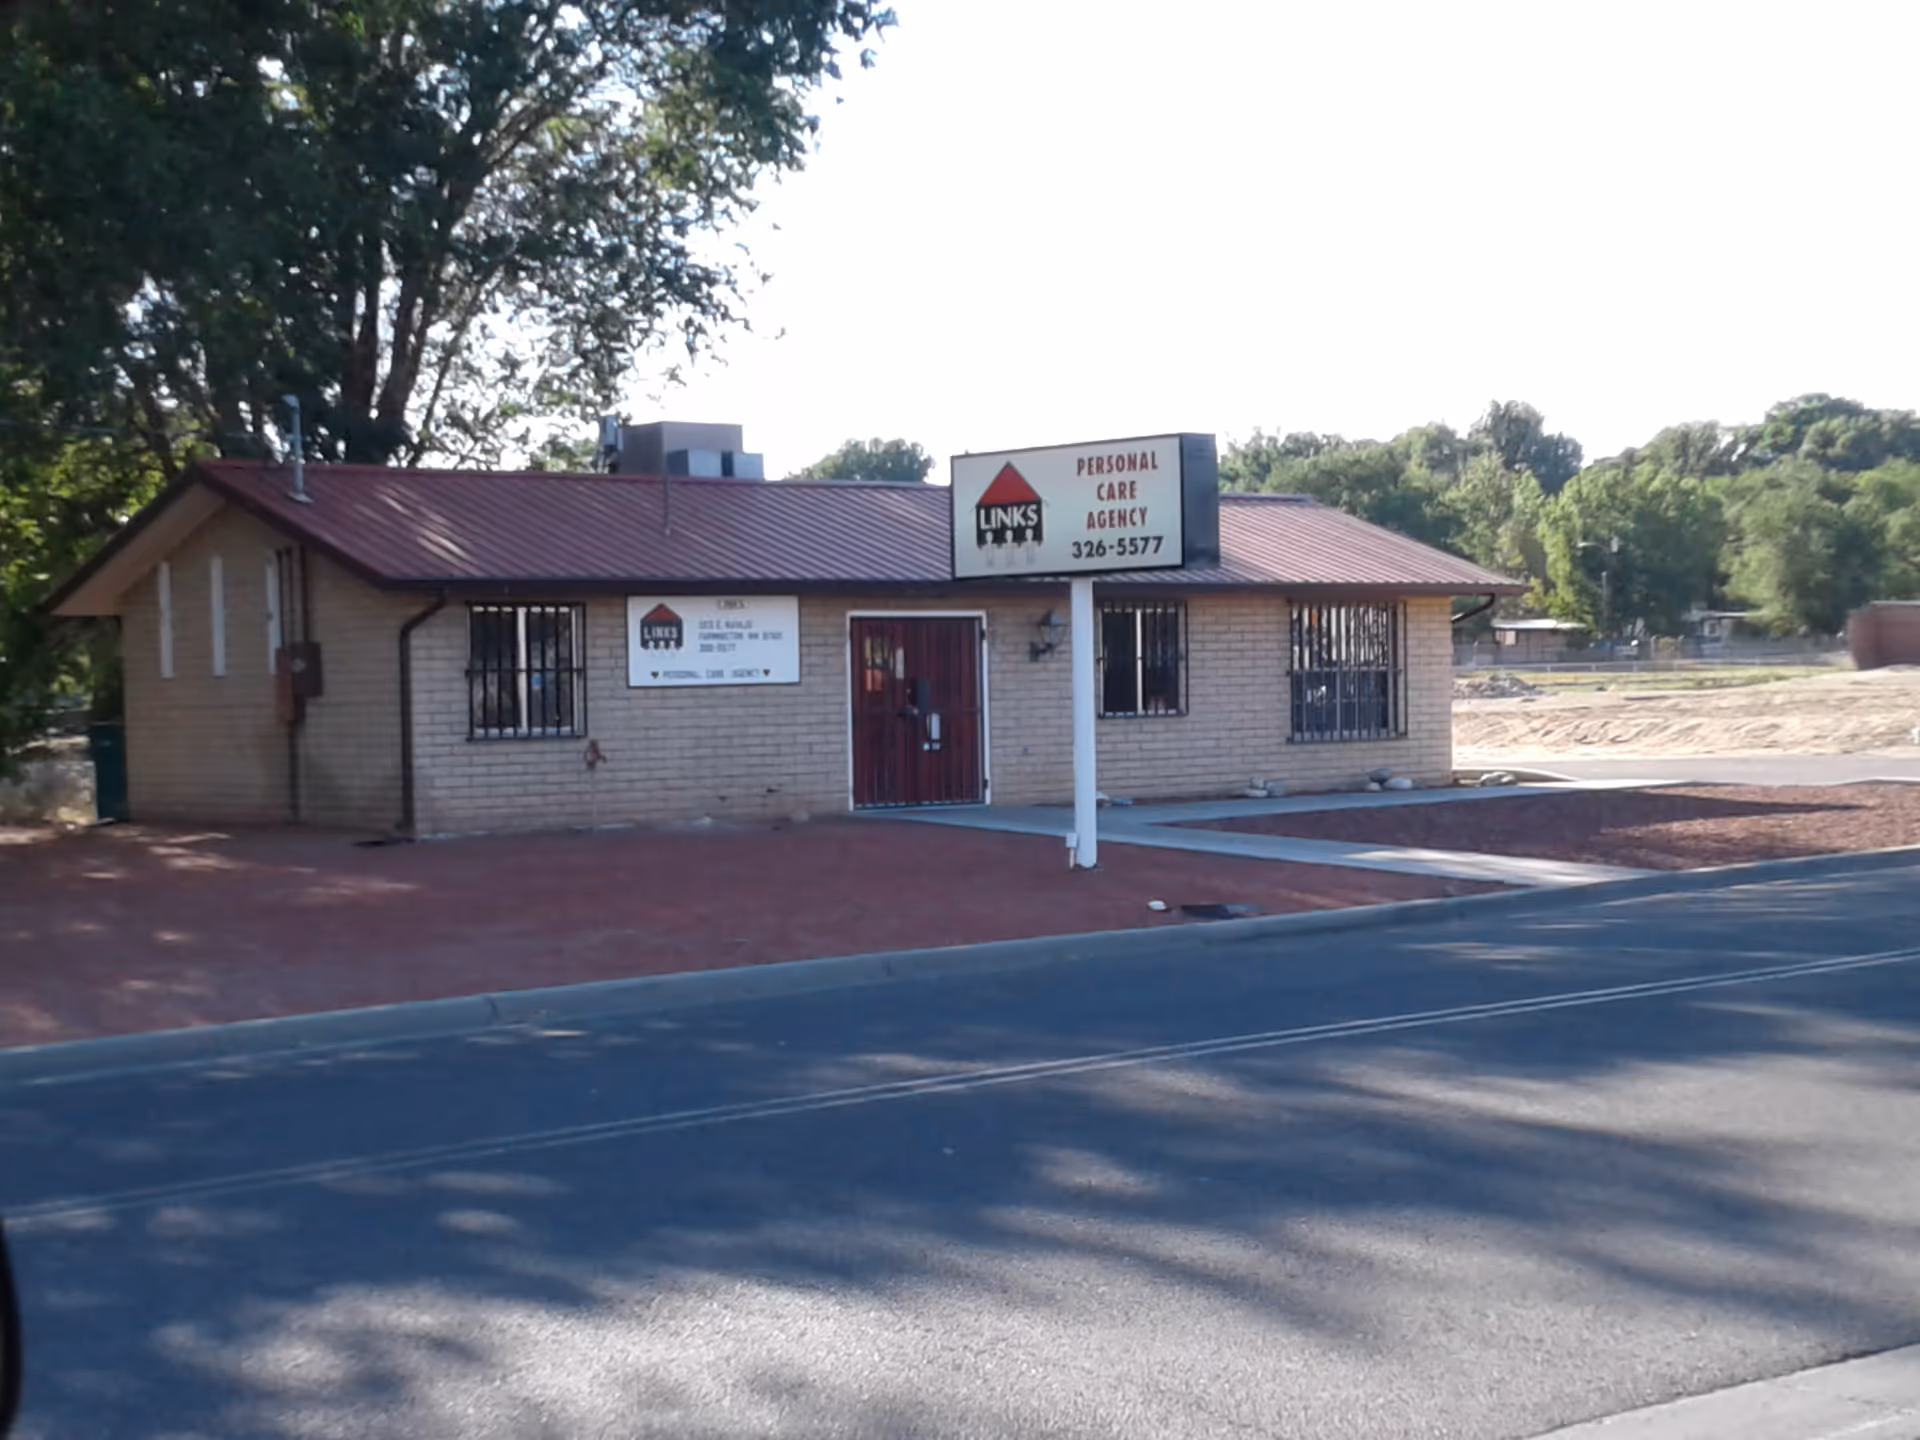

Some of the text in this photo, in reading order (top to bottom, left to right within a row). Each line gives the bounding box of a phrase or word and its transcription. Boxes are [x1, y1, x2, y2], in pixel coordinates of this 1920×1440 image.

[1077, 451, 1158, 476] PERSONAL
[1097, 481, 1137, 502] CARE
[979, 504, 1039, 530] LINKS
[1087, 507, 1148, 530] AGENCY
[1072, 535, 1164, 559] 326-5577
